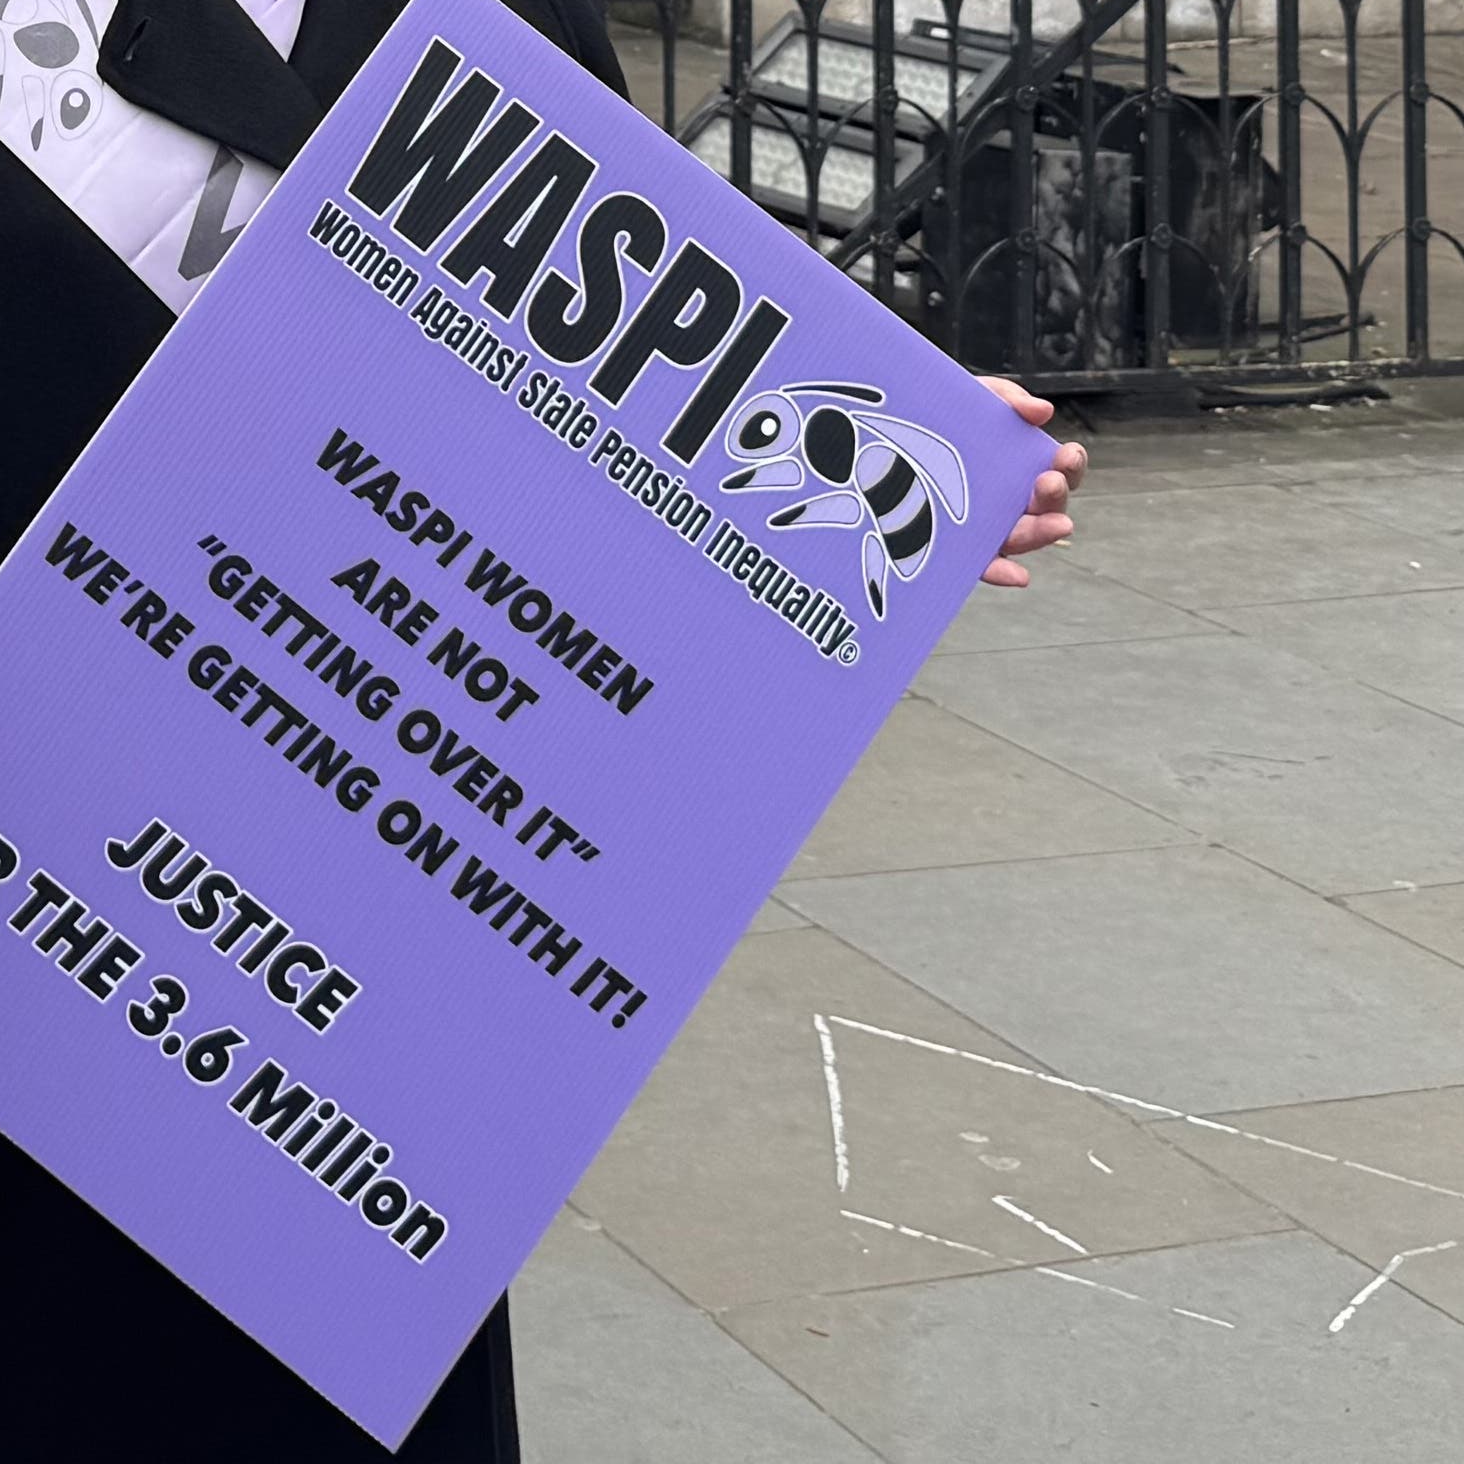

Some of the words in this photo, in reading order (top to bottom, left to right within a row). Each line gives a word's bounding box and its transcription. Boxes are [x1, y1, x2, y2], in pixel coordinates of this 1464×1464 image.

[306, 198, 421, 308] Women
[407, 284, 530, 394] Against
[515, 369, 599, 451] State
[588, 427, 714, 544] Pension
[345, 36, 790, 467] WASPI
[314, 425, 475, 570] WASPI
[462, 546, 656, 717] WOMEN
[328, 556, 441, 648] ARE
[424, 625, 542, 723] NOT
[43, 519, 197, 661] WE’RE
[185, 642, 382, 814] GETTING
[375, 798, 461, 878] ON
[448, 853, 584, 978] WITH
[567, 955, 649, 1030] IT!
[104, 818, 360, 1034] JUSTICE
[394, 707, 525, 829] OVER
[6, 869, 143, 1002] THE
[126, 975, 247, 1084] 3.6
[227, 1059, 447, 1262] Million
